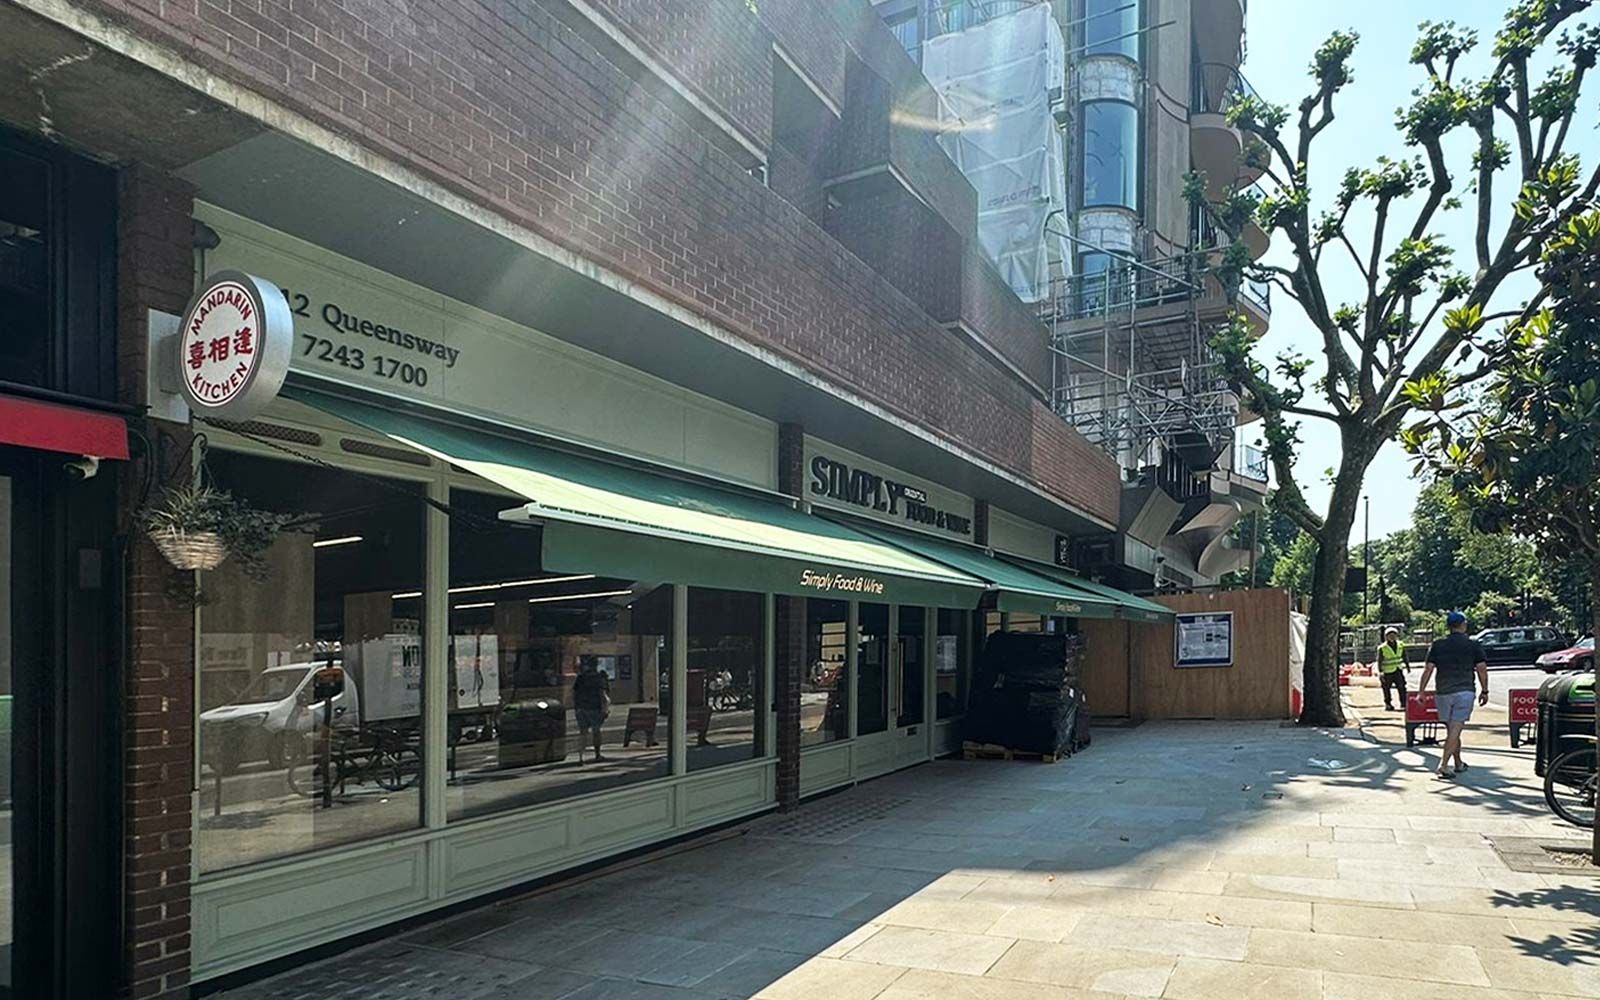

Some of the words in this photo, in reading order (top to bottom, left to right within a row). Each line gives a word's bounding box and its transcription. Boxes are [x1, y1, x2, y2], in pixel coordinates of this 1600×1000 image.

[191, 290, 252, 336] MANDARIN
[322, 303, 460, 368] Queensway
[192, 362, 248, 399] KITCHEN
[302, 333, 365, 370] 7243
[372, 355, 428, 387] 1700
[811, 456, 898, 515] SIMPLY
[800, 569, 833, 591] Simply
[832, 574, 857, 591] Food
[1513, 696, 1539, 705] FOO
[1517, 707, 1539, 715] CLO
